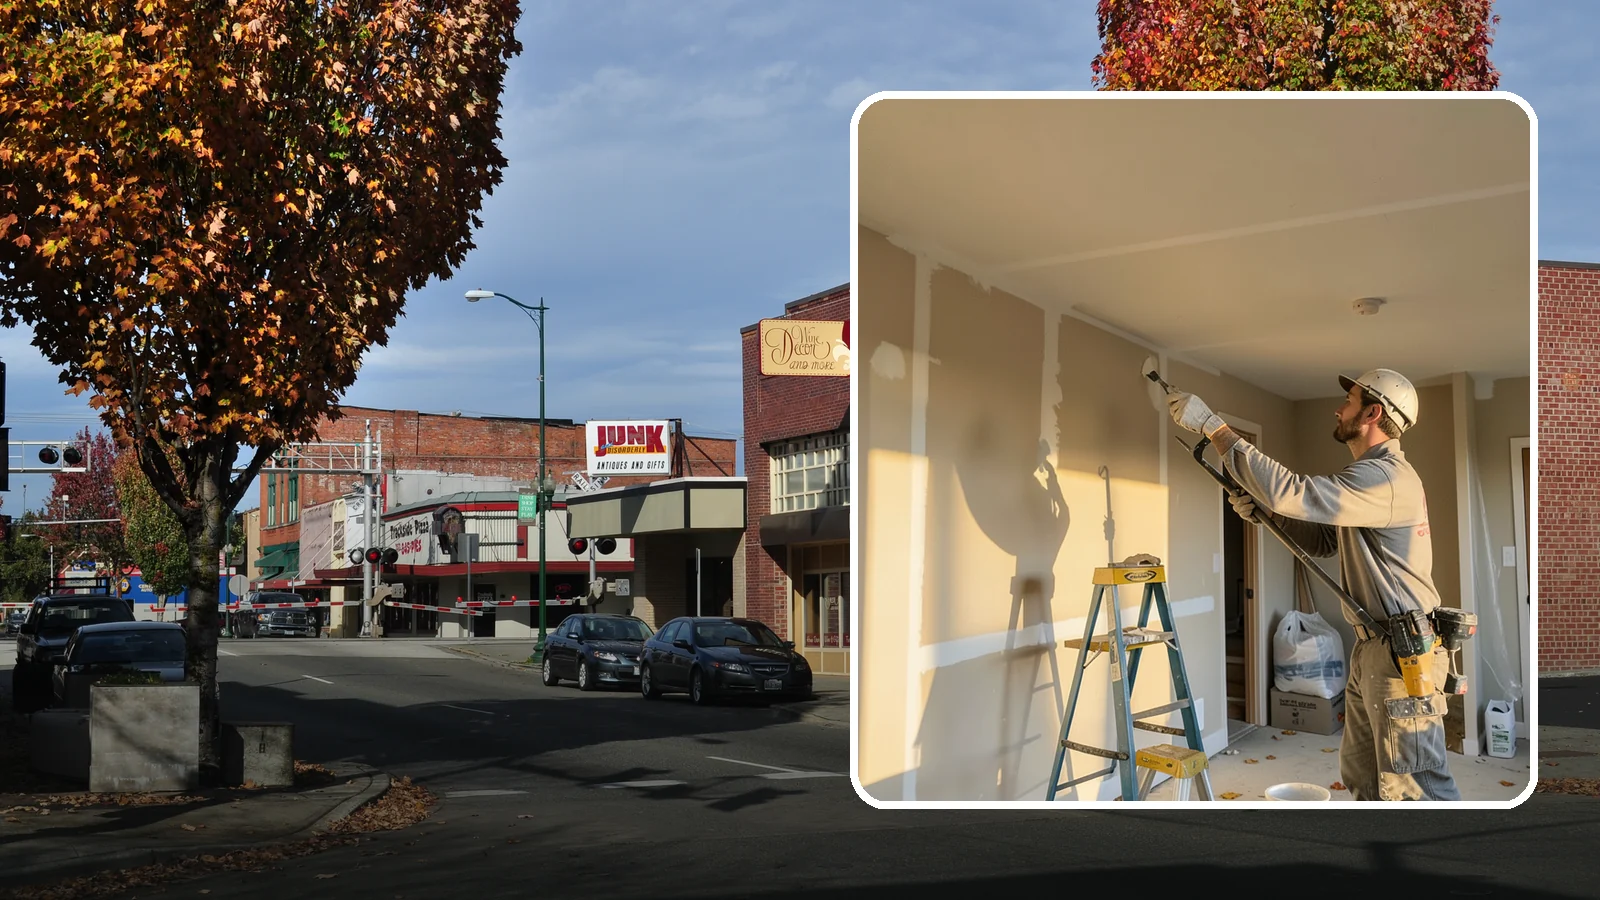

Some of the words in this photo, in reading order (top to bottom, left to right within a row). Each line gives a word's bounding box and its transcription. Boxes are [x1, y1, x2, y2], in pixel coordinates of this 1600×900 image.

[595, 425, 665, 457] JUNK
[597, 461, 628, 470] ANTIQUES
[631, 461, 643, 470] AND
[647, 461, 665, 470] GIFTS
[573, 473, 589, 492] RAIL
[390, 521, 412, 539] Trackside
[415, 519, 429, 534] Pizza
